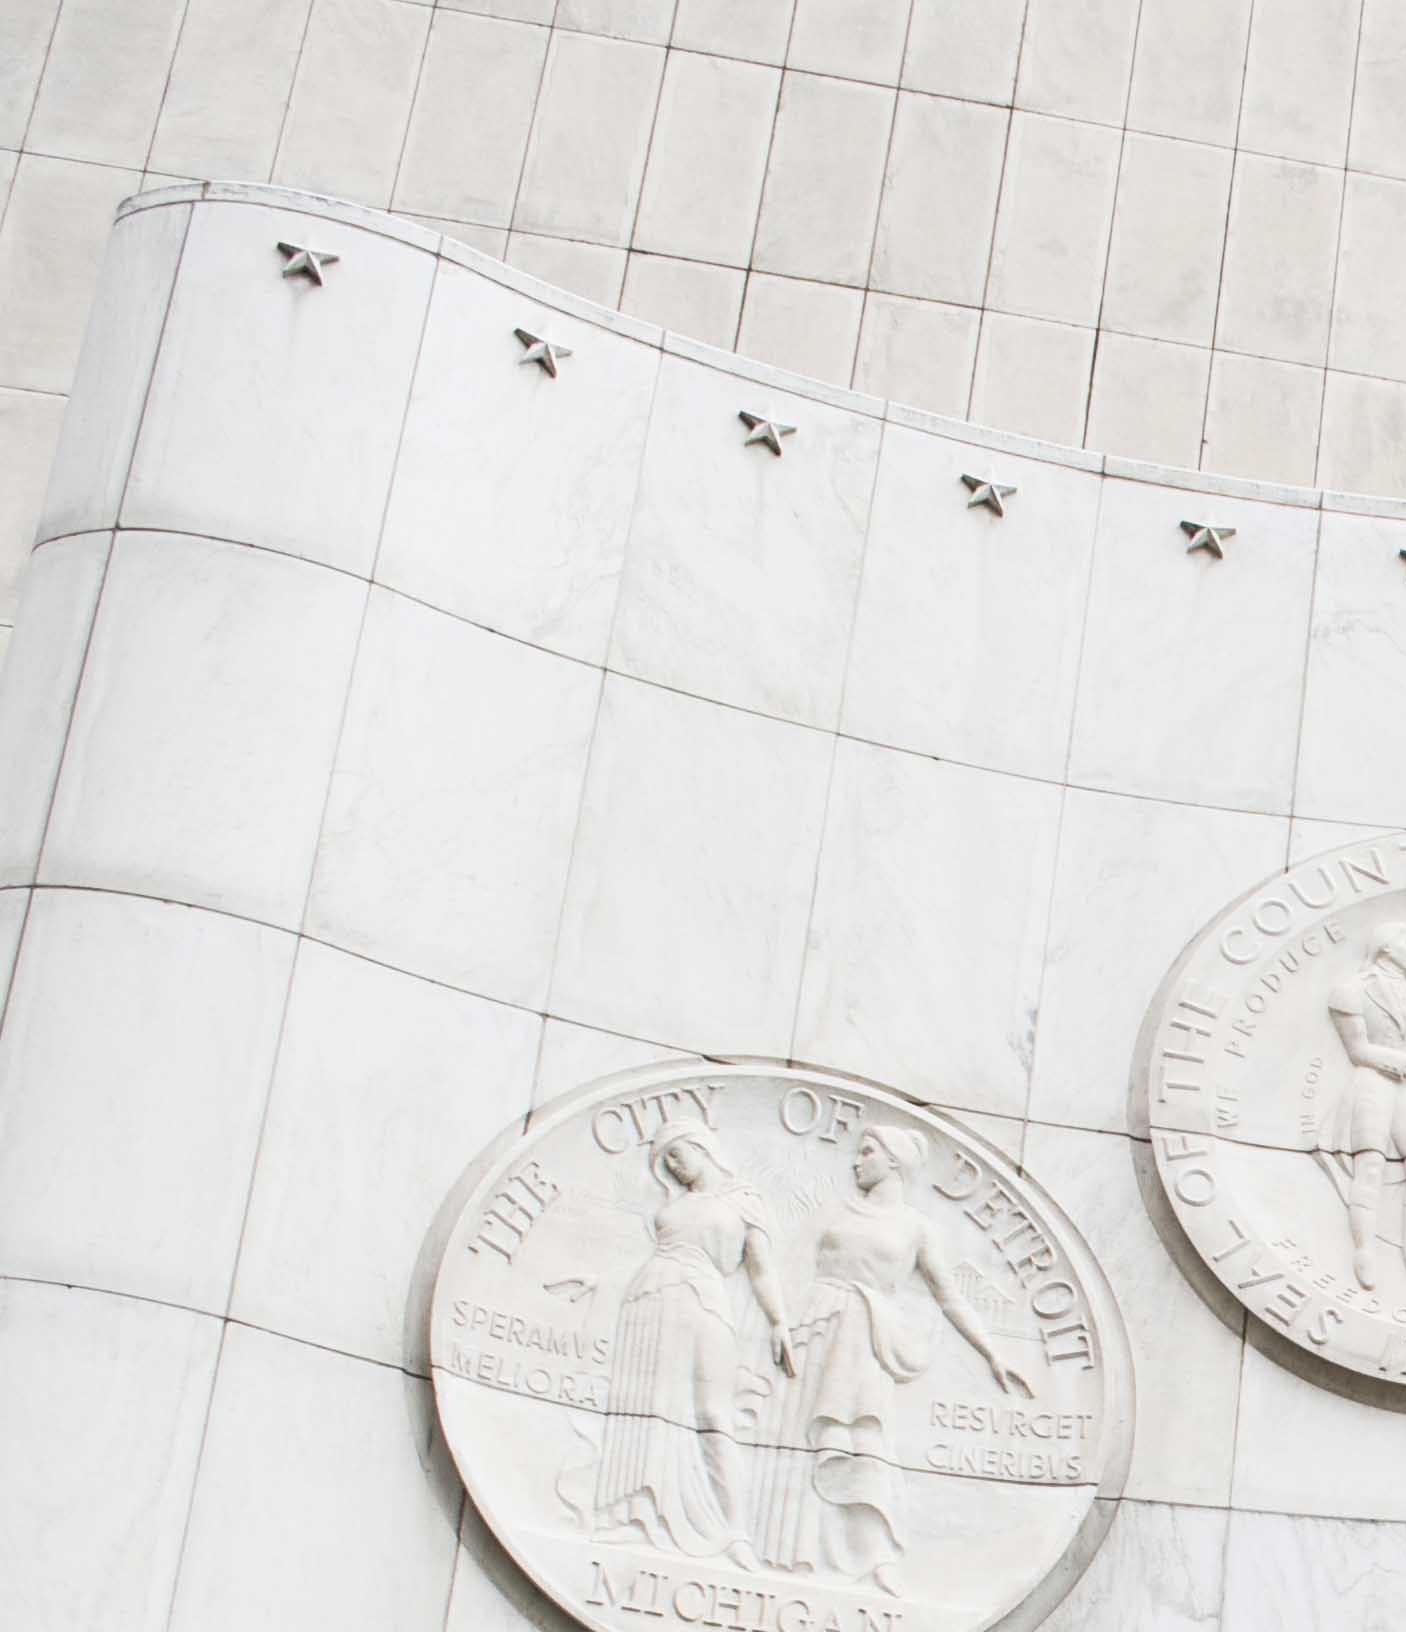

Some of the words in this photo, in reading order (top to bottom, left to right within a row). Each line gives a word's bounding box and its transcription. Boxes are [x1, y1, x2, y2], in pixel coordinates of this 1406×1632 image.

[1156, 979, 1224, 1103] THE
[1224, 919, 1348, 1058] PRODUCE
[467, 1159, 562, 1266] THE
[591, 1083, 726, 1156] CITY
[777, 1087, 865, 1146] OF
[931, 1151, 1096, 1372] DETROIT
[1160, 1134, 1216, 1208] OF
[1211, 1219, 1344, 1345] SEAL
[450, 1343, 600, 1408] MELIORA
